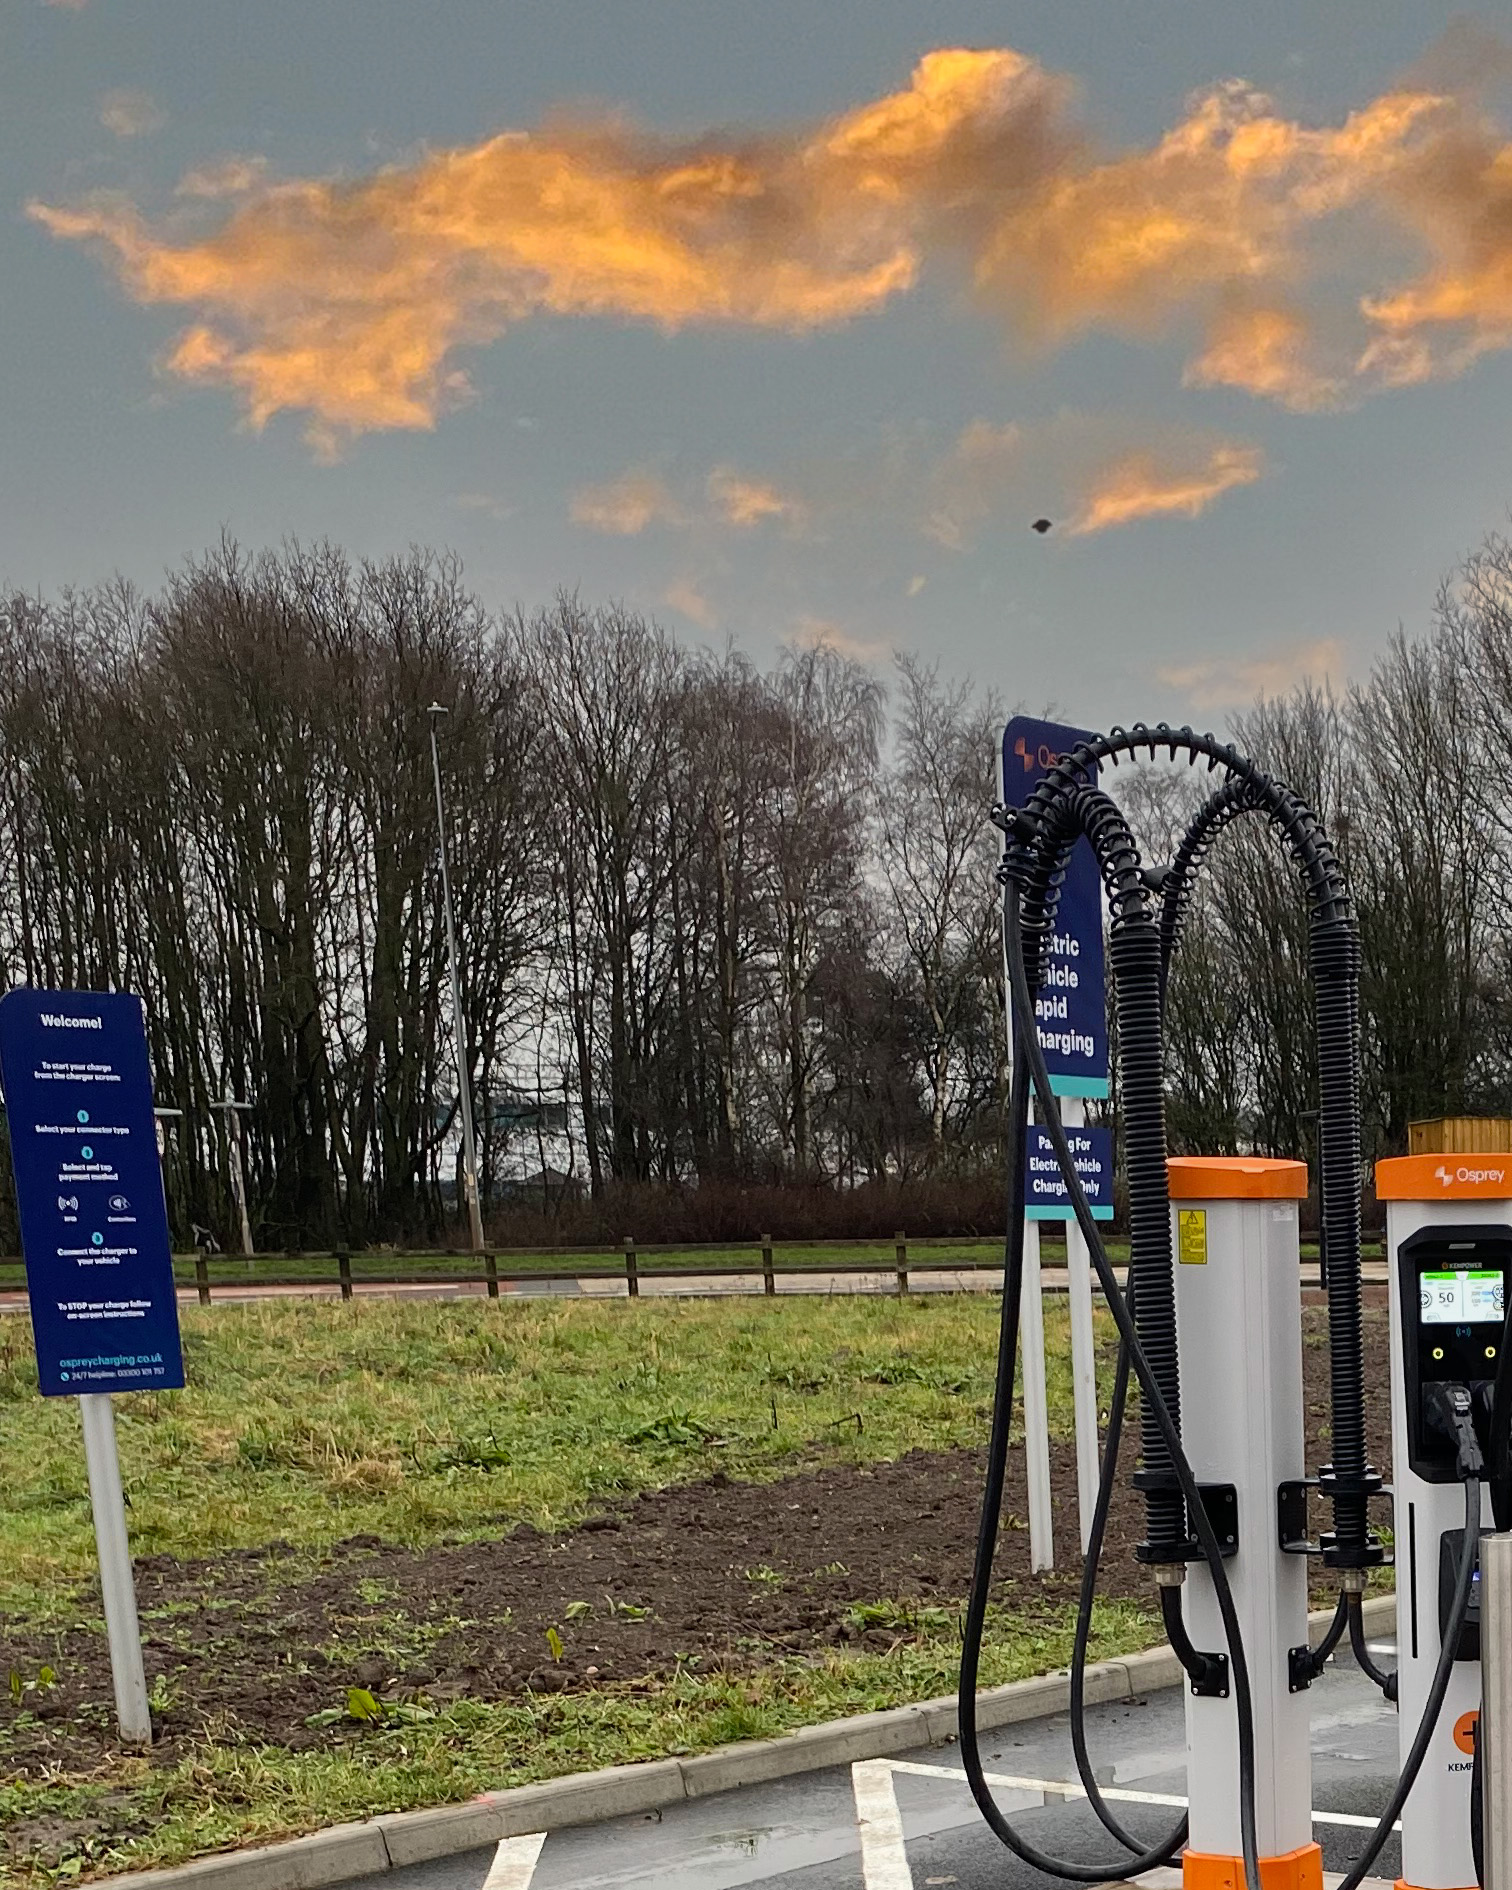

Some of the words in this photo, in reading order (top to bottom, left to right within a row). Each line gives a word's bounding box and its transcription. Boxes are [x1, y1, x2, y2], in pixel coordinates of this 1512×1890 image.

[1035, 995, 1068, 1021] apid
[40, 1013, 103, 1030] Welcome!
[1036, 1025, 1094, 1057] harging
[1075, 1136, 1092, 1151] For
[1074, 1157, 1102, 1173] ehicle
[1456, 1167, 1505, 1185] Osprey
[1438, 1292, 1454, 1304] 50
[59, 1352, 164, 1369] ospreycharging.co.uk
